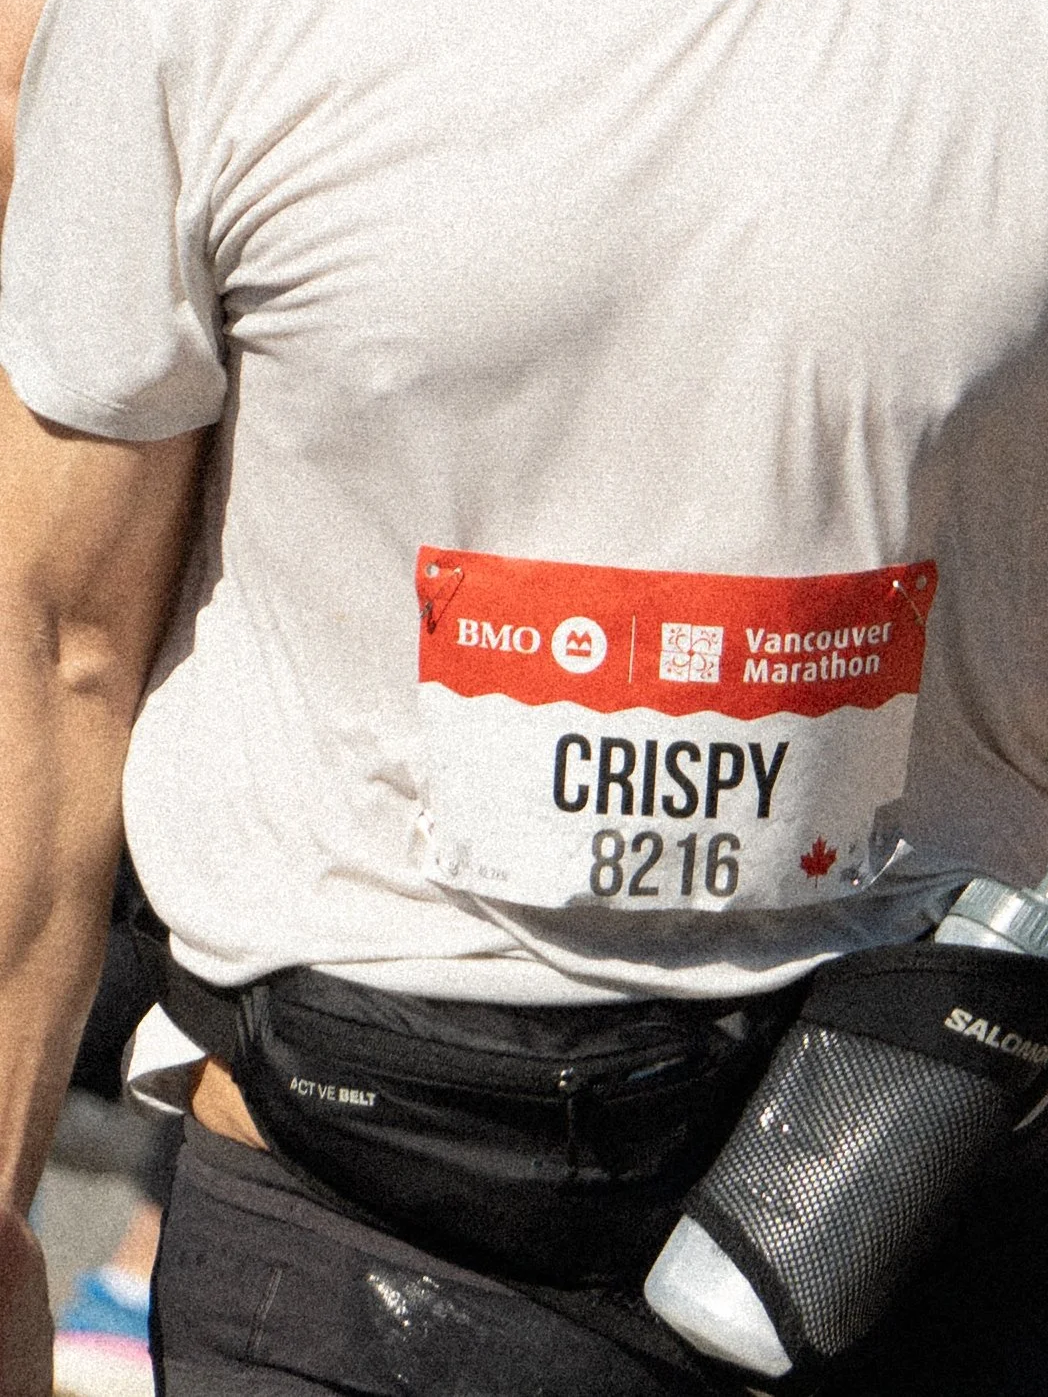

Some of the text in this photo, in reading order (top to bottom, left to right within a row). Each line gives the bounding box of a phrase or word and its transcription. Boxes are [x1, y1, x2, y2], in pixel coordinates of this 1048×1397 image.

[457, 617, 540, 654] BMO
[745, 620, 893, 655] Vancouver
[742, 652, 881, 685] Marathon
[553, 733, 790, 820] CRISPY
[589, 828, 742, 897] 8216
[290, 1077, 377, 1107] ACTVE BELT
